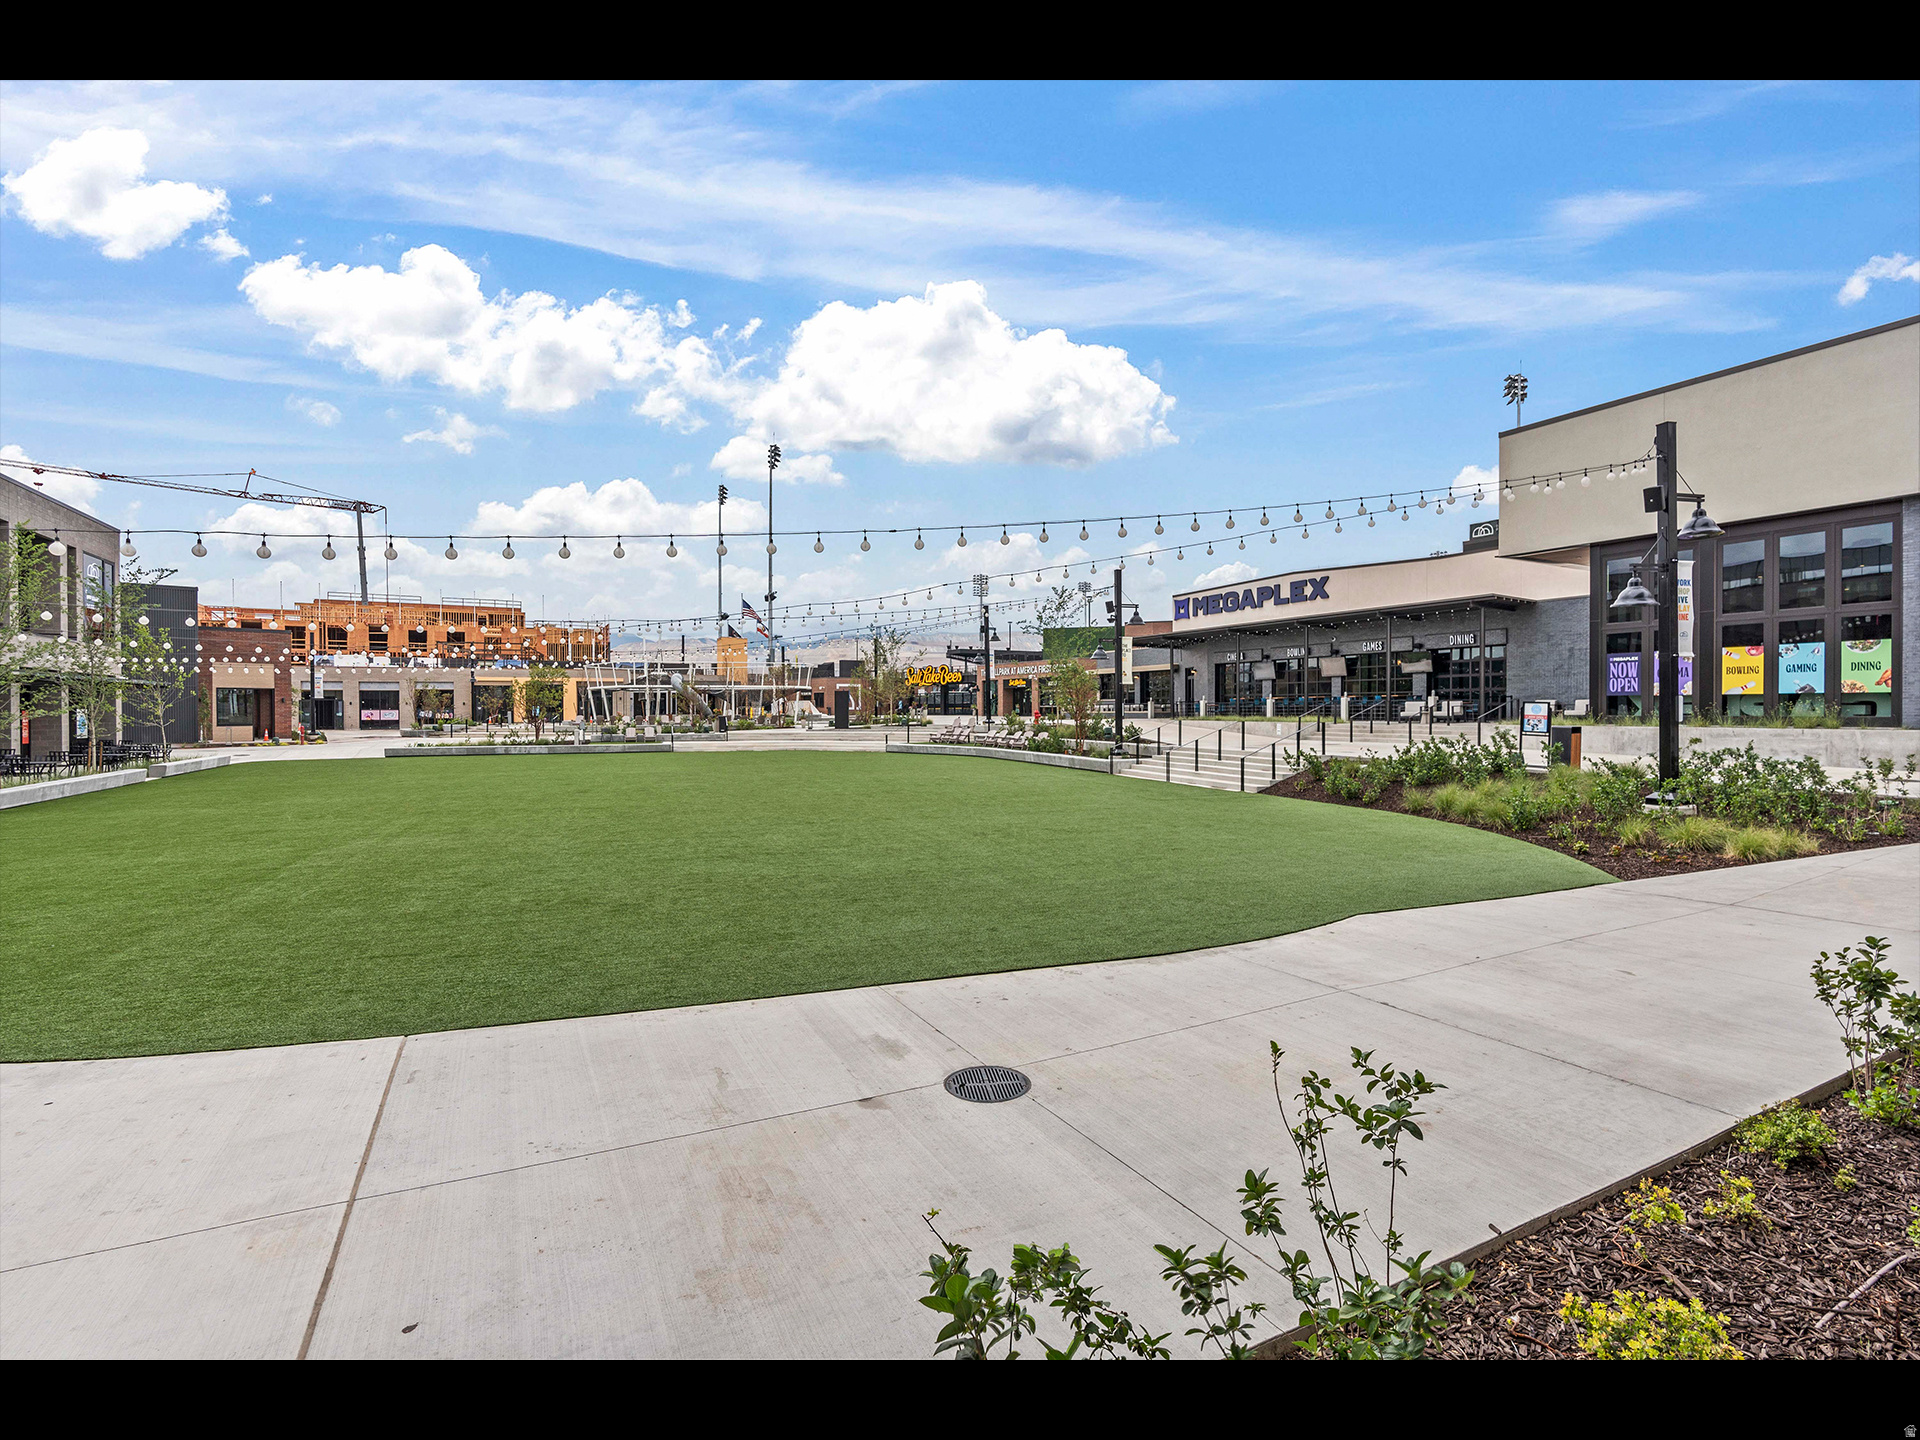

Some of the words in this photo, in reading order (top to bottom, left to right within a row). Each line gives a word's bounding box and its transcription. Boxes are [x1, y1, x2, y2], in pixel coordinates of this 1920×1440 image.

[1192, 576, 1330, 617] MEGAPLEX
[1449, 634, 1475, 645] DINING
[1362, 641, 1383, 651] GAMES
[1226, 652, 1244, 662] CINEA
[994, 667, 1010, 676] LLPARK
[1017, 665, 1038, 675] AMERICA
[1610, 662, 1638, 678] NOW
[1726, 665, 1760, 675] BOWLING
[1785, 663, 1817, 673] GAMING
[1850, 661, 1882, 671] DINING
[905, 667, 922, 686] Salt
[919, 665, 941, 686] Lake
[939, 664, 962, 685] Bees
[1609, 677, 1638, 692] OPEN
